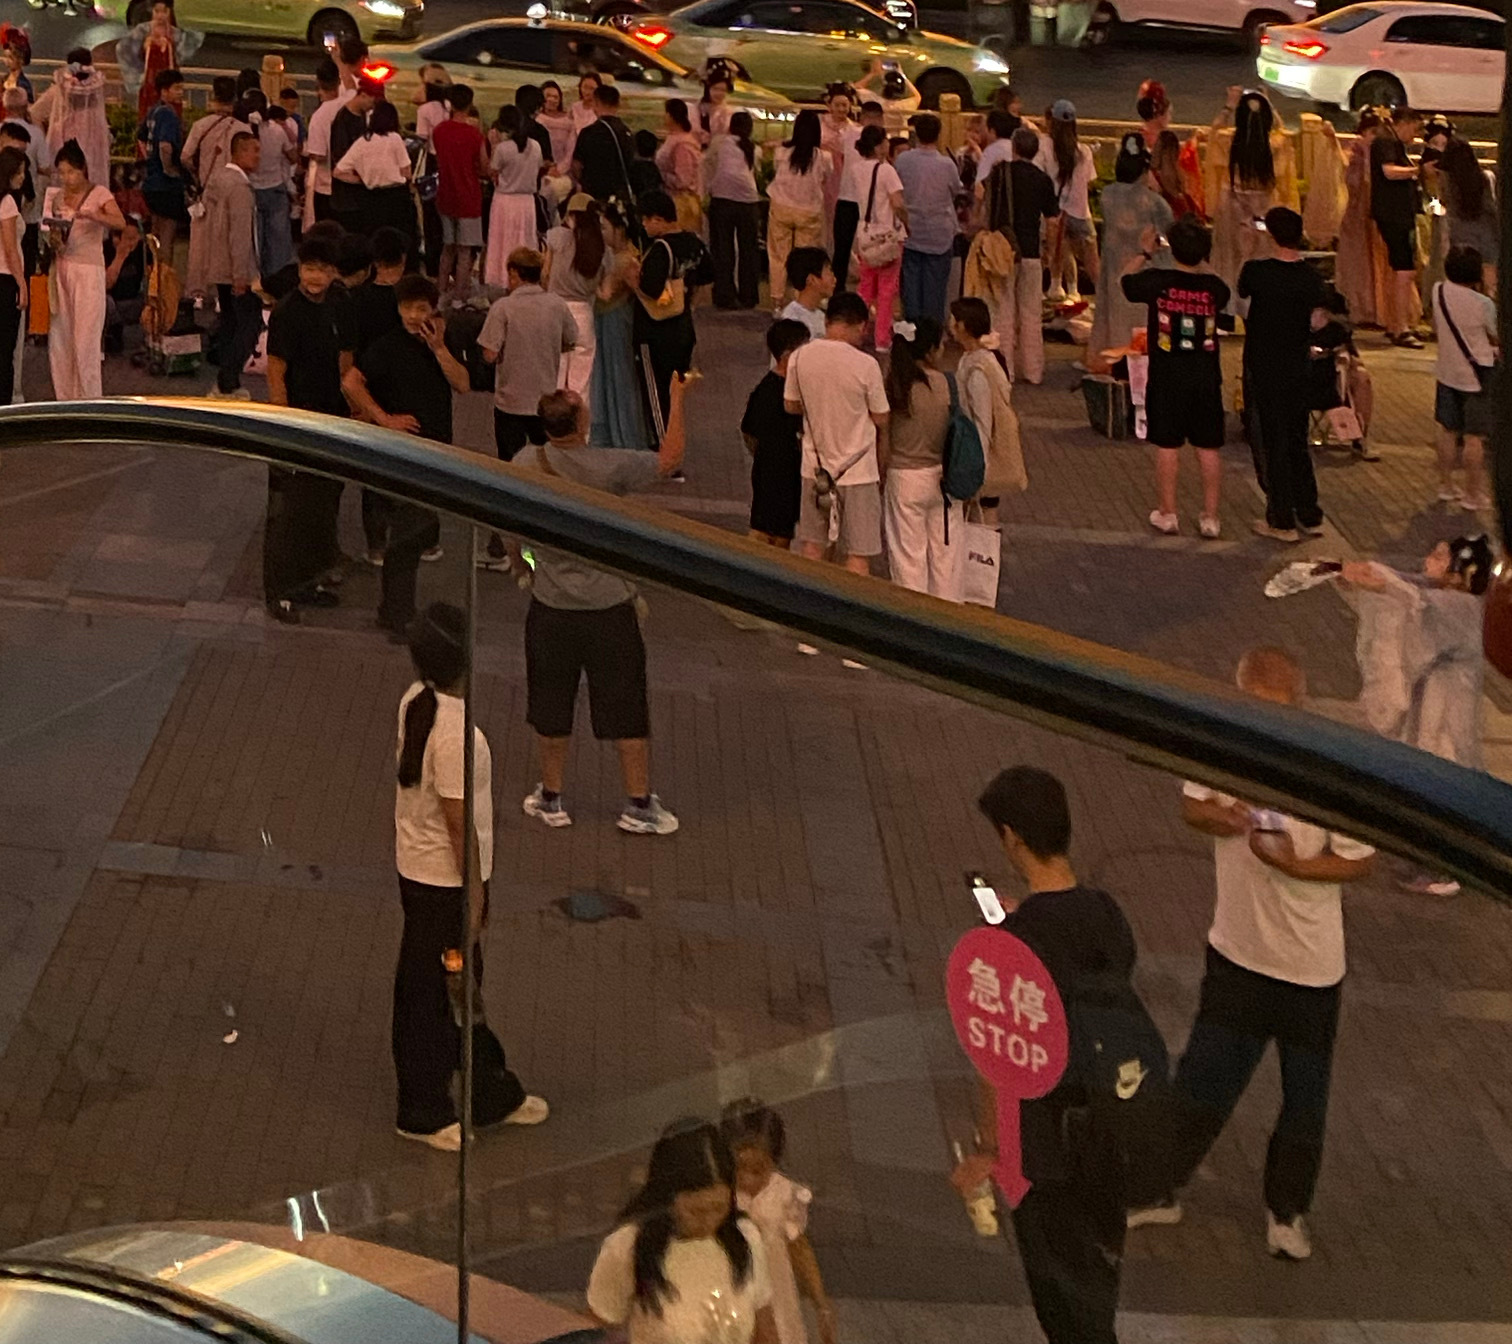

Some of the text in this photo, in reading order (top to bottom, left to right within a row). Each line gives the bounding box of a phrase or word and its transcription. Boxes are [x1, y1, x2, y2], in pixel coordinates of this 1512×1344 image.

[968, 551, 995, 567] FILA
[967, 957, 1049, 1032] 急停
[968, 1016, 1049, 1073] STOP
